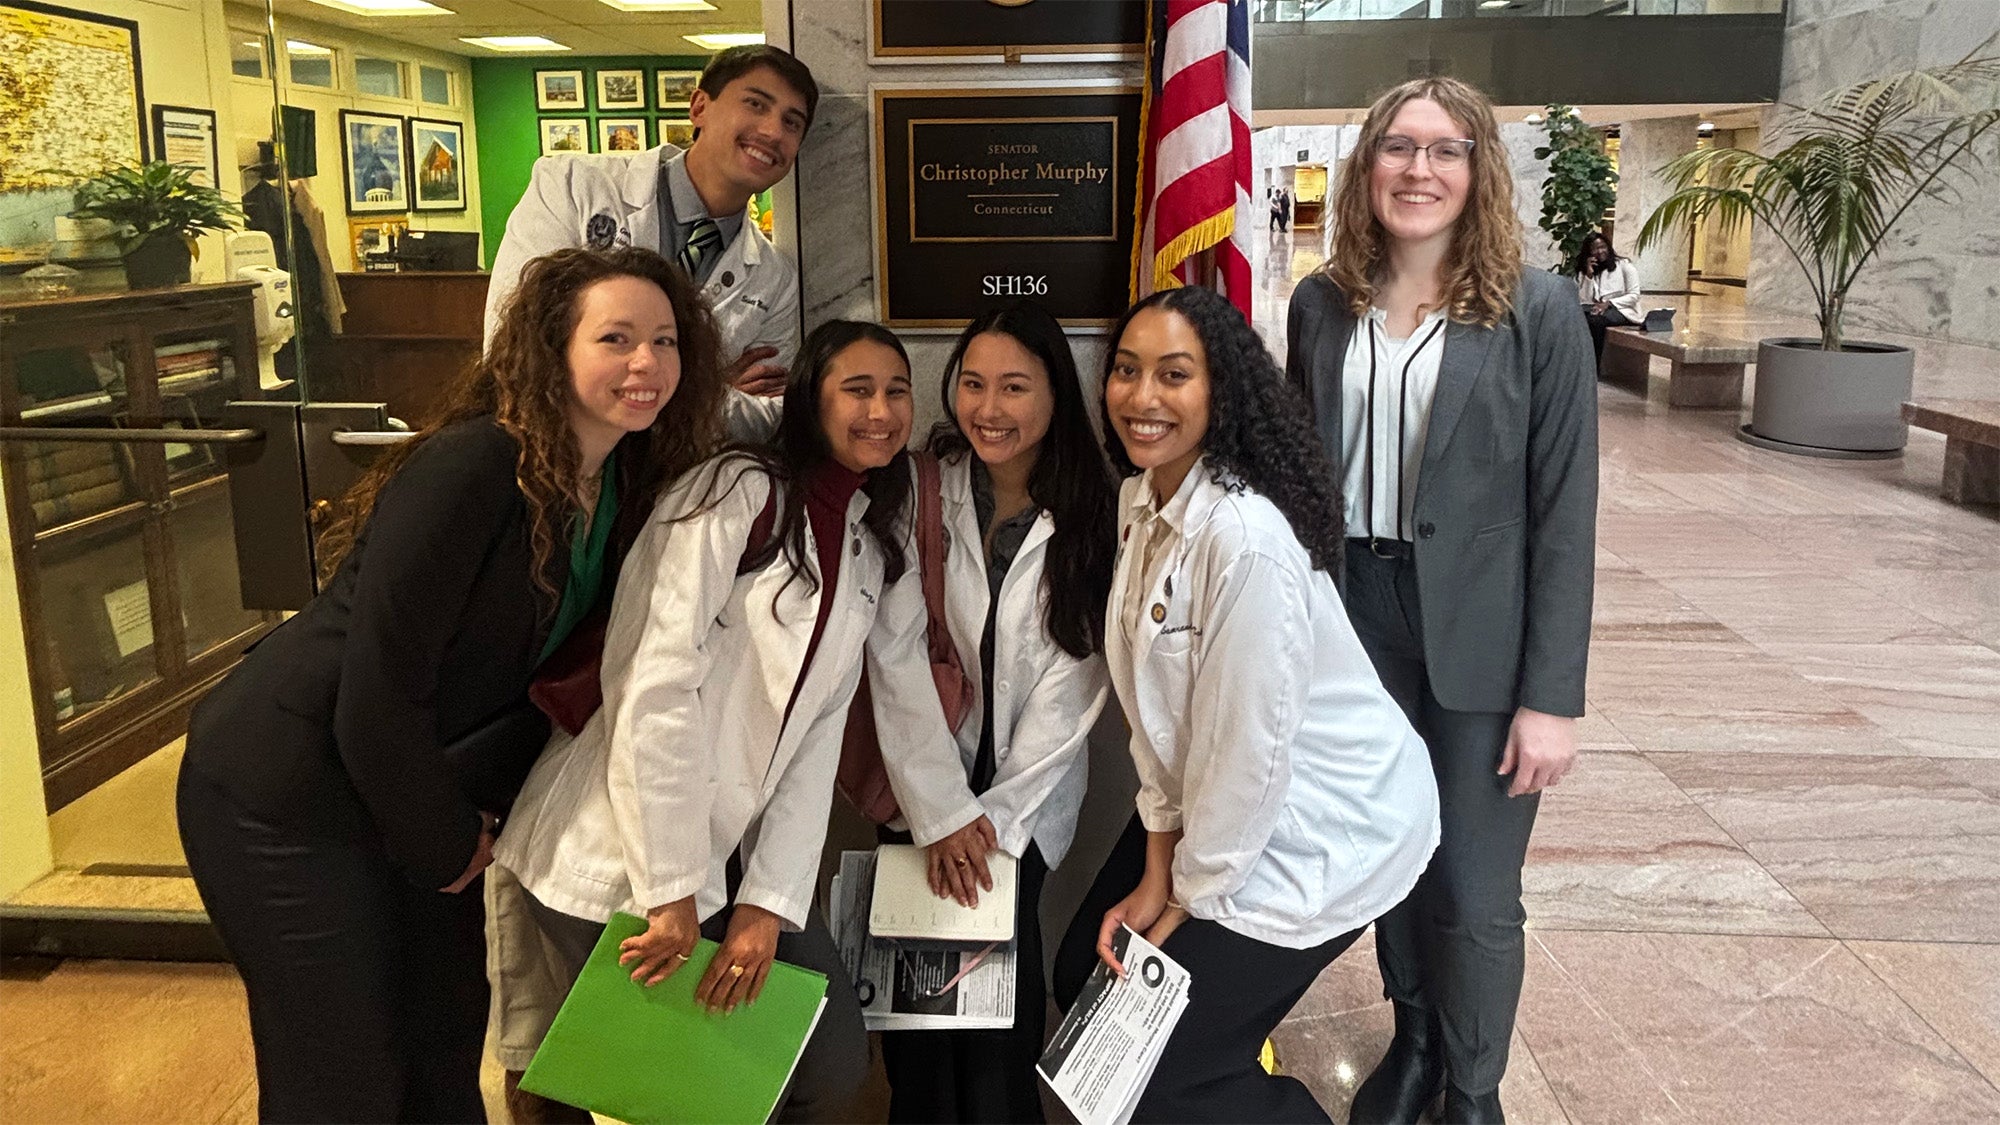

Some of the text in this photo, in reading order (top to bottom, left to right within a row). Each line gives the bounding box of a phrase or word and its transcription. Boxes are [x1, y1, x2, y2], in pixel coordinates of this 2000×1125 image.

[987, 144, 1039, 154] SENATOR
[920, 161, 1109, 186] Christopher Murphy
[974, 203, 1053, 215] Connecticut
[982, 275, 1048, 295] SH136
[1095, 978, 1113, 1002] IMPACT
